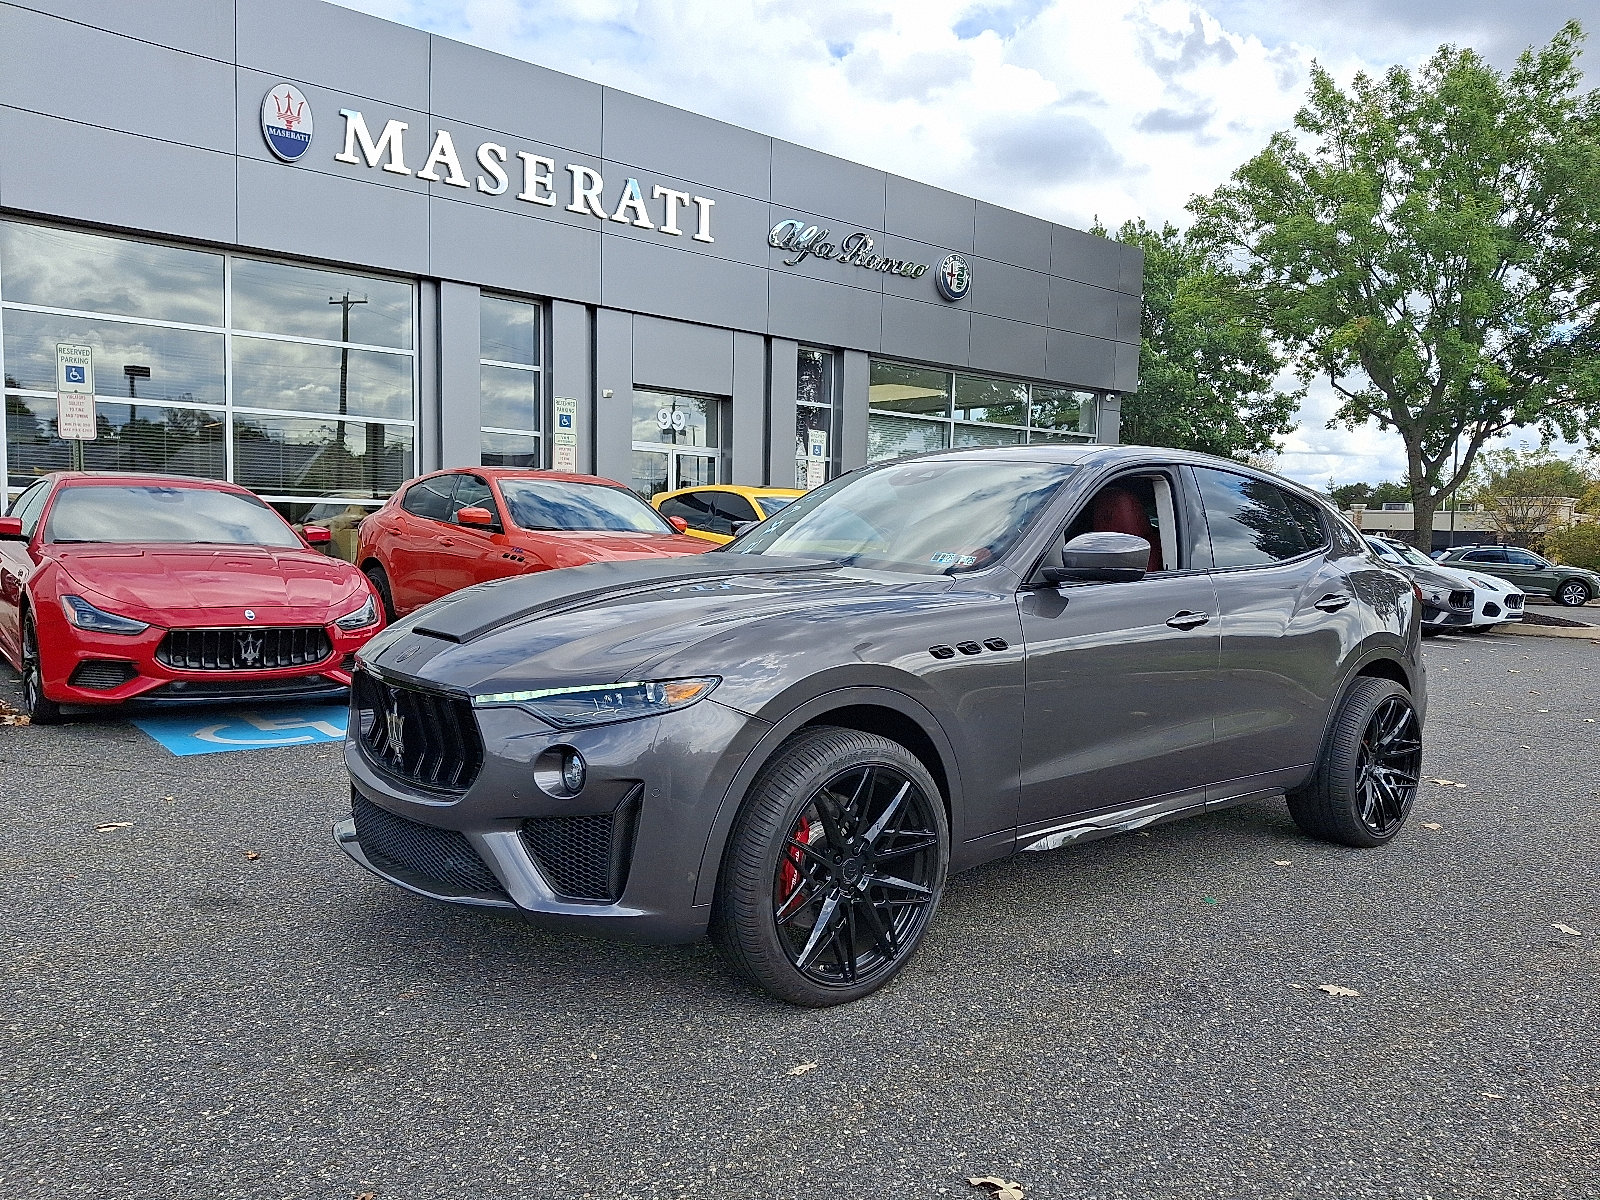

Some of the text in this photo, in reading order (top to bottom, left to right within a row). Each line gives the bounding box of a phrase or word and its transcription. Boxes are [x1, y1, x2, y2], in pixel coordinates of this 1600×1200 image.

[268, 127, 309, 142] MASERATI
[334, 108, 716, 243] MASERATI
[768, 219, 930, 279] Alfa Romeo
[58, 347, 90, 356] RESERVED
[60, 356, 89, 364] PARKING
[656, 408, 686, 431] 99
